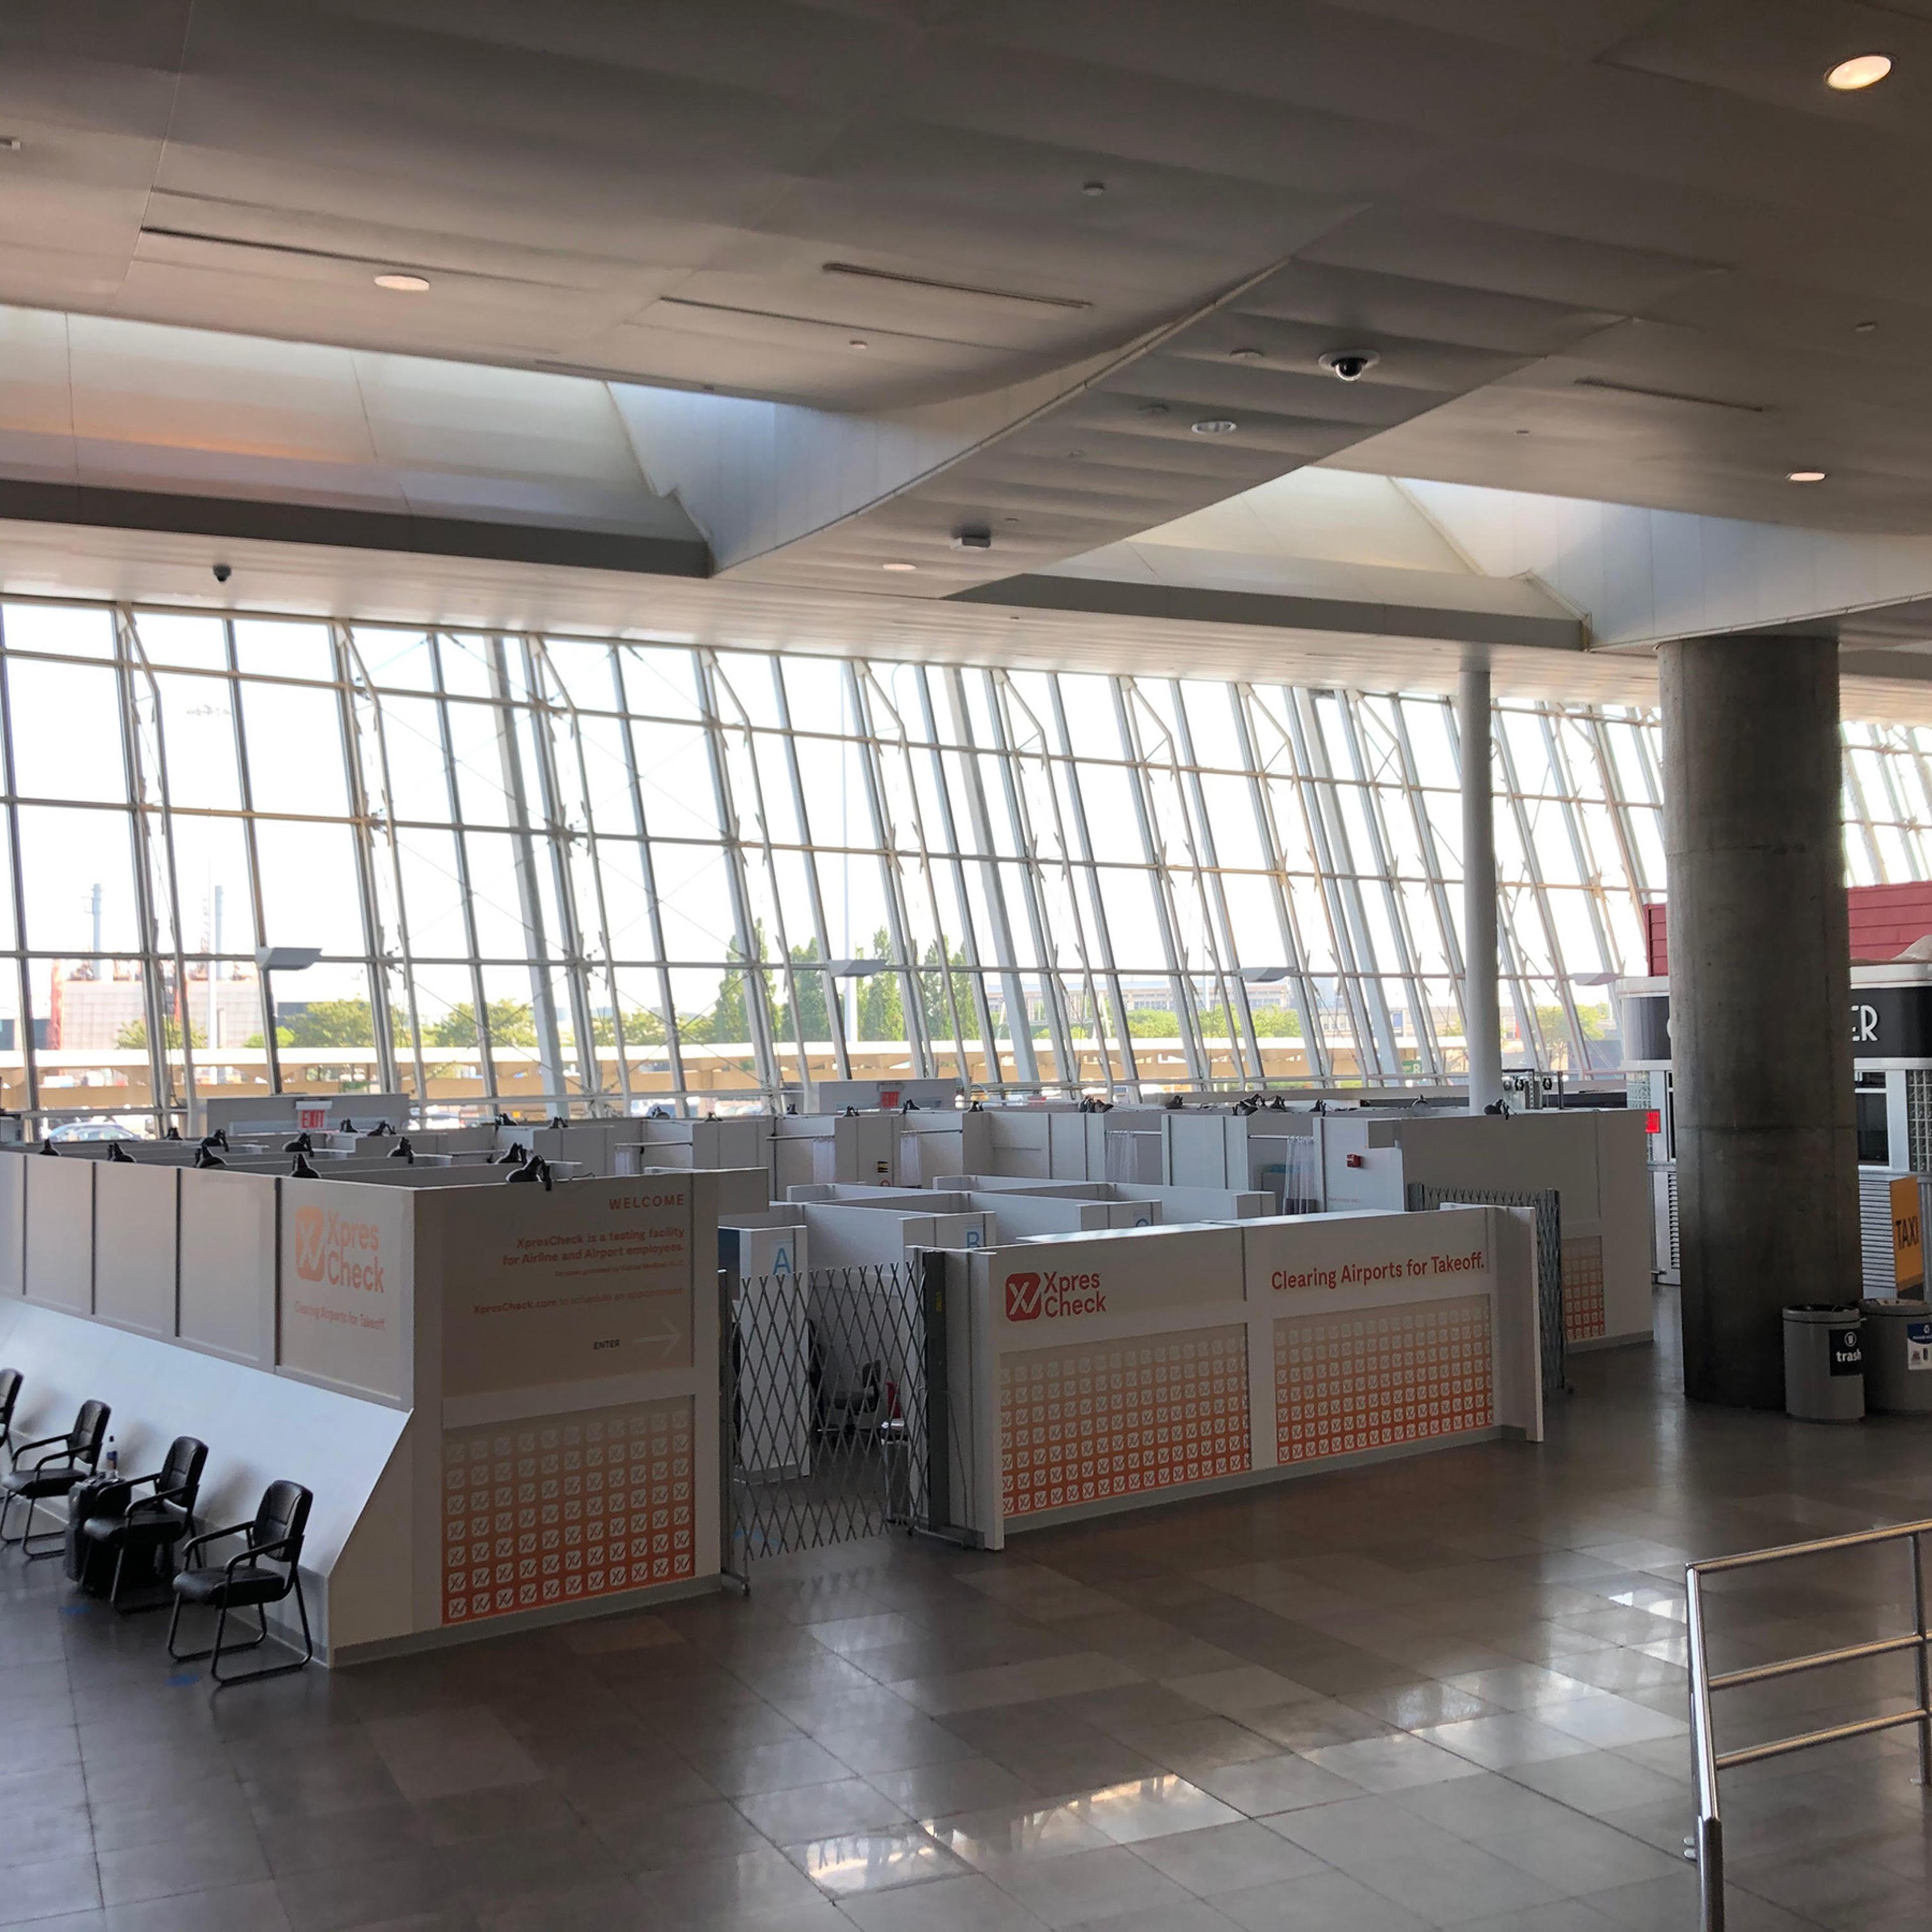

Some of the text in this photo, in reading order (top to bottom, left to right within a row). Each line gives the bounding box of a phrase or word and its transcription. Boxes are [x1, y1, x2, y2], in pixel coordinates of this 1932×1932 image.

[302, 1110, 325, 1129] EXIT
[609, 1194, 684, 1210] WELCOME
[327, 1210, 380, 1251] Xpres
[516, 1234, 584, 1250] XpresCheck
[588, 1234, 596, 1243] is
[609, 1230, 646, 1242] testing
[649, 1226, 685, 1239] facility
[1895, 1216, 1919, 1250] TAXI
[503, 1254, 519, 1266] for
[522, 1251, 558, 1264] Airline
[561, 1249, 582, 1261] and
[585, 1246, 623, 1260] Airport
[772, 1247, 791, 1275] A
[328, 1250, 384, 1293] Check
[1043, 1271, 1100, 1294] Xpres
[1271, 1251, 1485, 1290] Clearing Airports for Takeoff.
[1045, 1291, 1106, 1318] Check
[593, 1339, 620, 1350] ENTER
